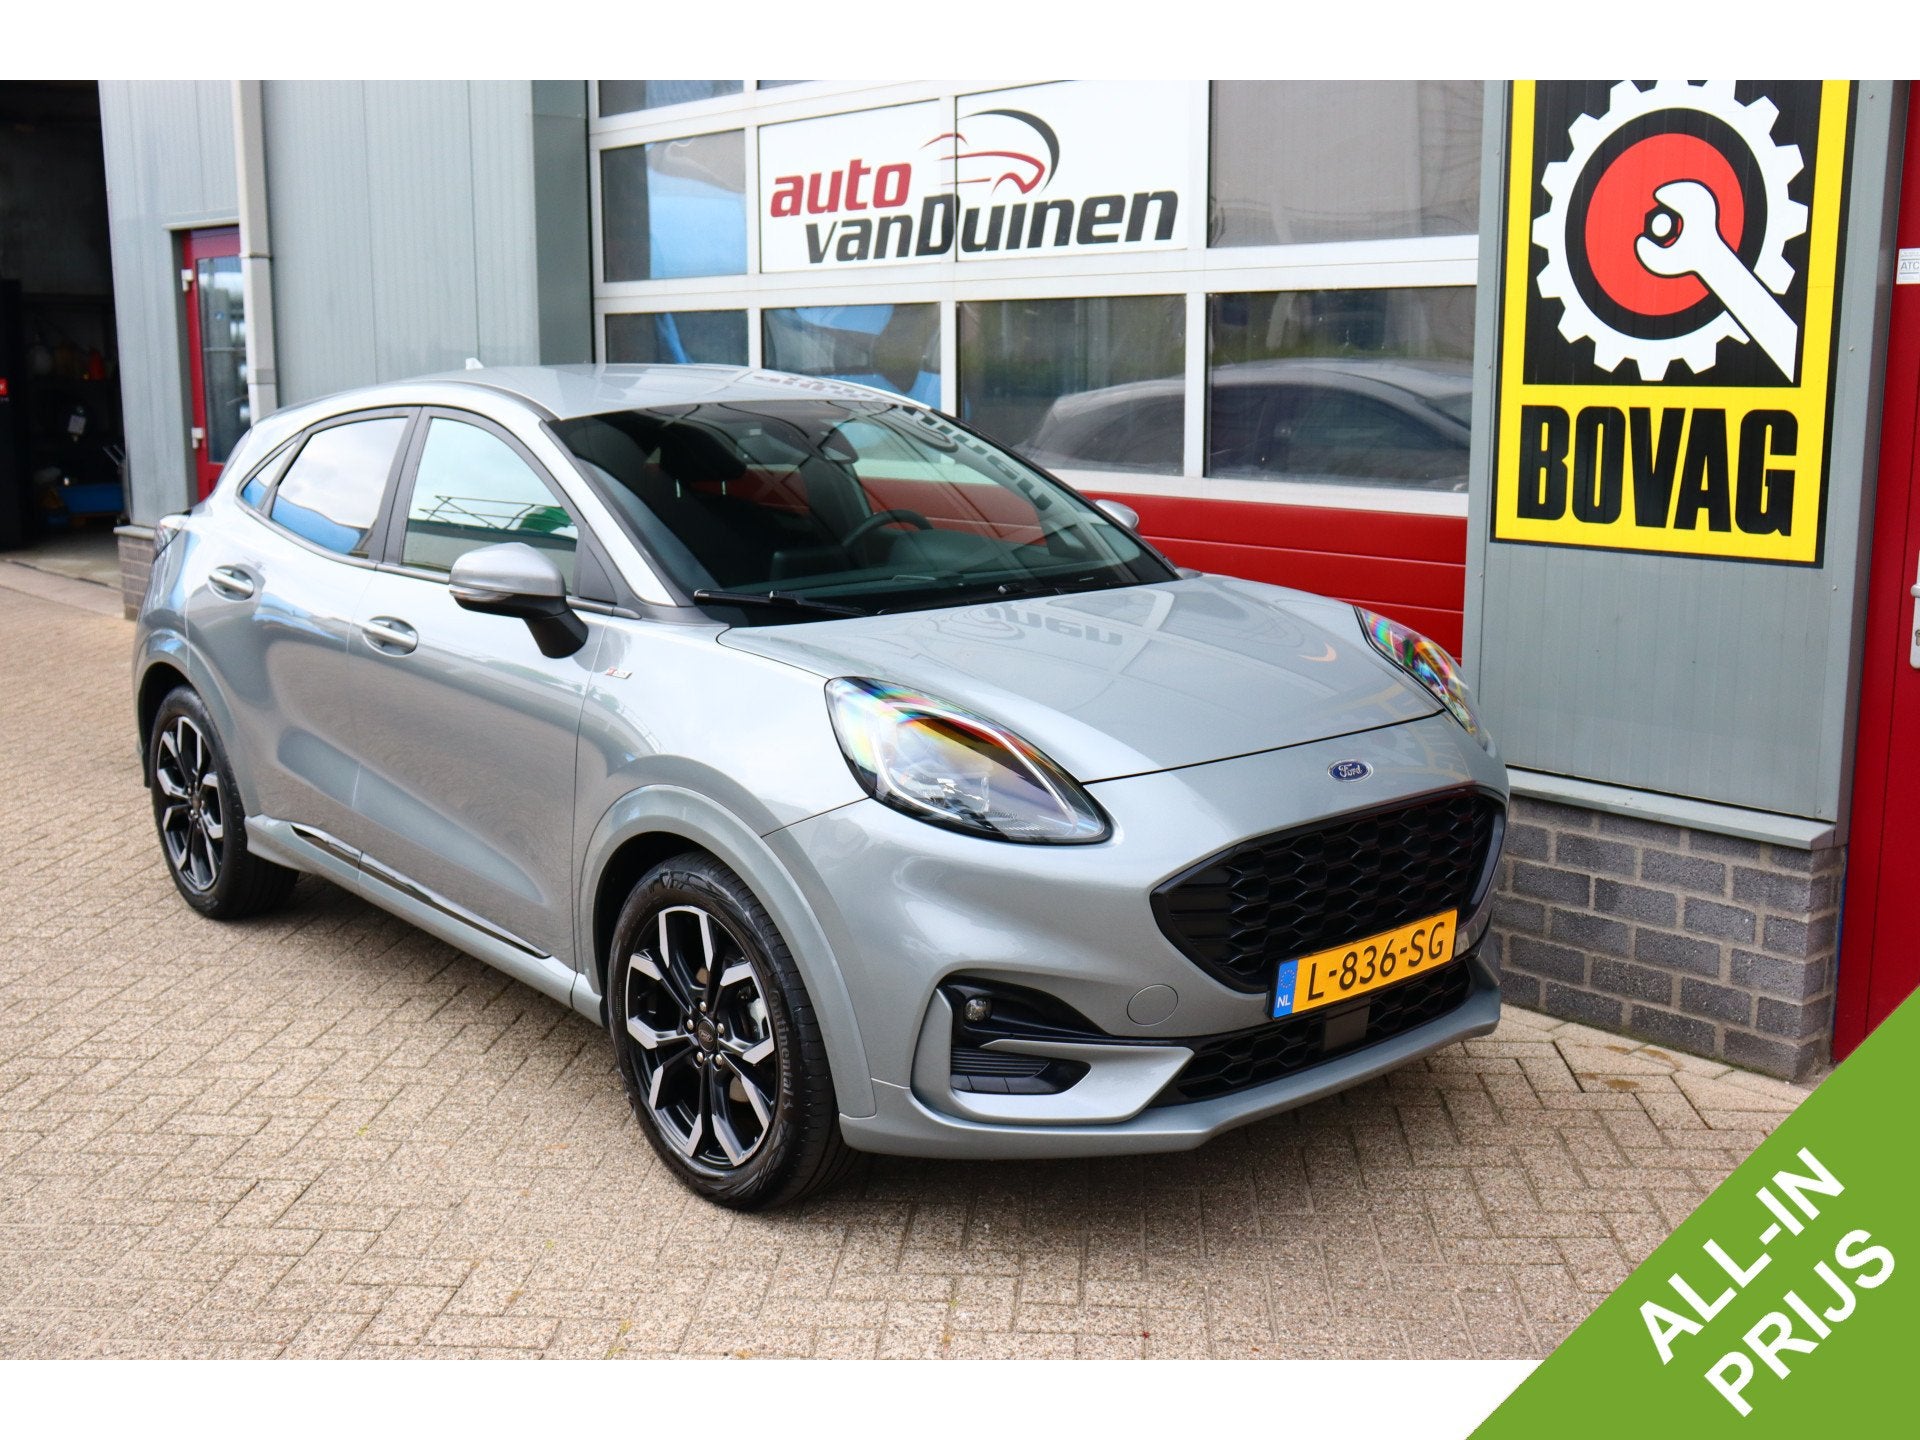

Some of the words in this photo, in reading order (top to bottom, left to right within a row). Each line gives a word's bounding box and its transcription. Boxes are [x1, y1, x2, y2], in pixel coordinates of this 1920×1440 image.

[771, 159, 912, 218] auto
[1517, 405, 1798, 536] BOVAG
[1307, 921, 1445, 1001] L-836-SG
[1277, 994, 1291, 1008] NL
